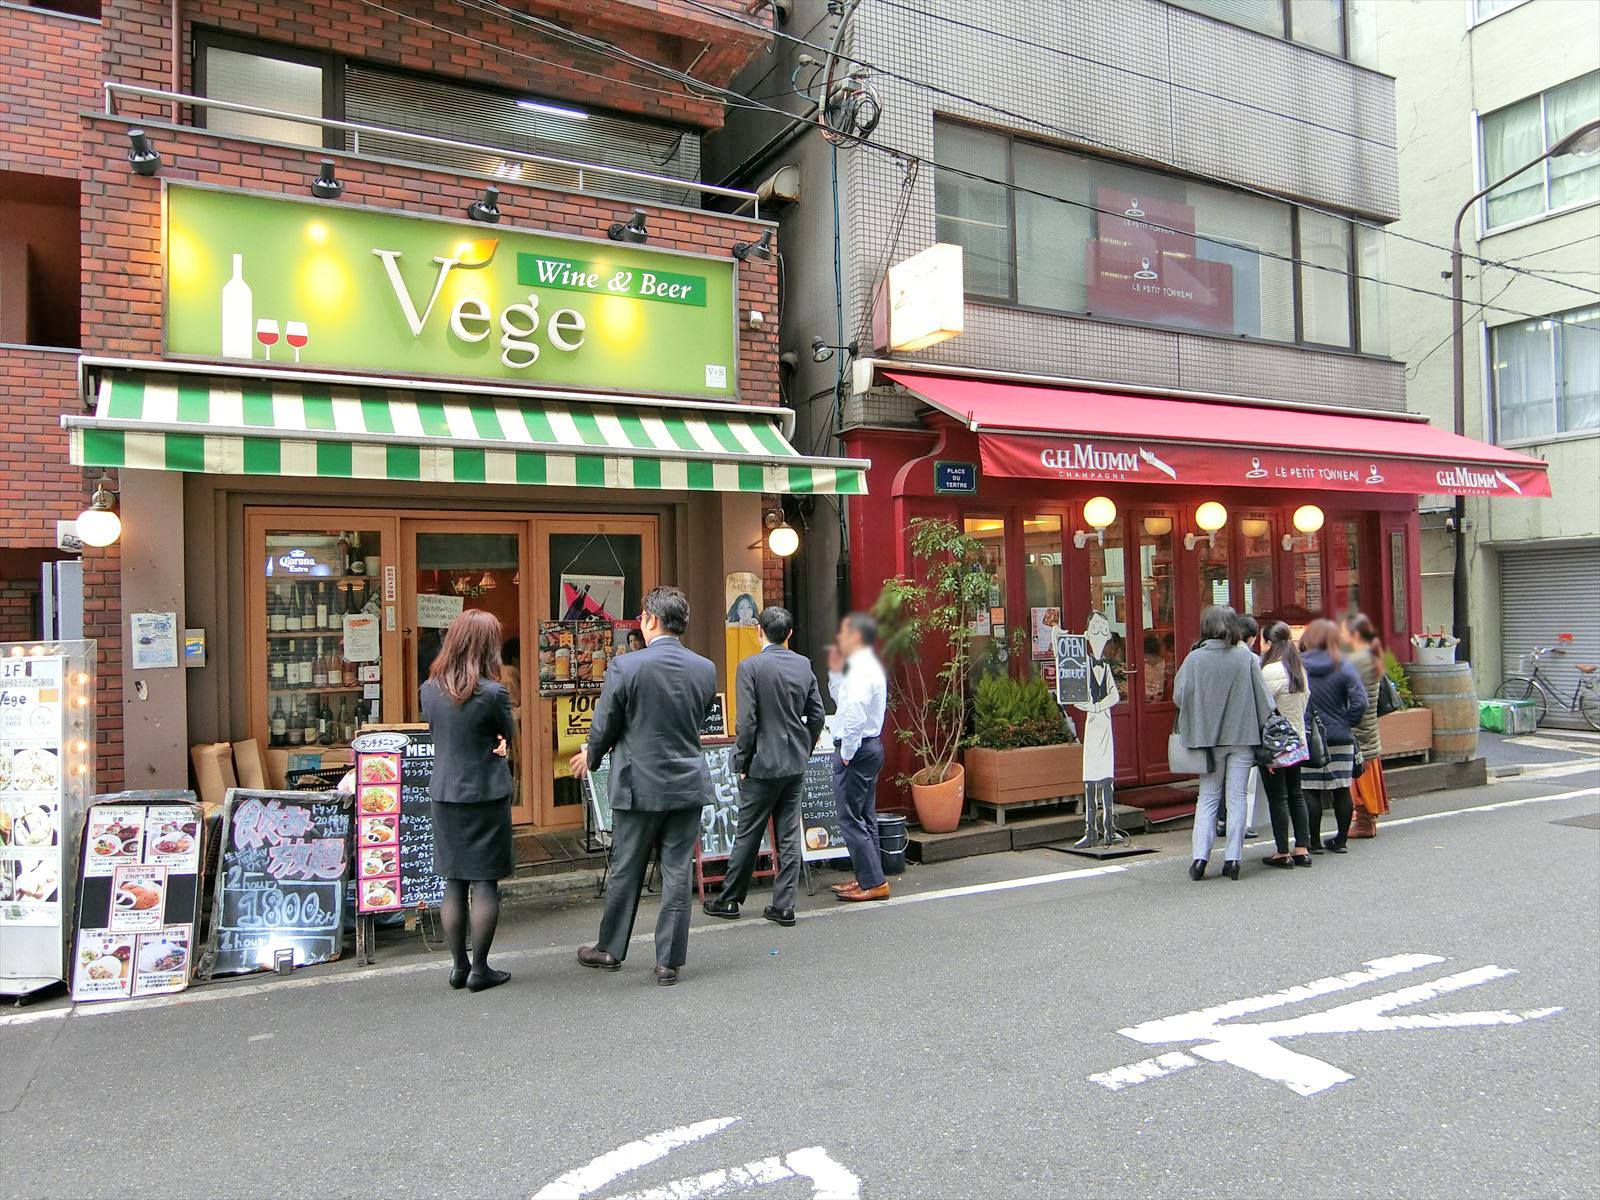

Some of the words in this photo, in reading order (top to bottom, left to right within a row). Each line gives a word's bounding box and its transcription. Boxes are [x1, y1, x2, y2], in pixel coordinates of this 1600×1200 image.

[535, 259, 599, 289] Wine
[607, 271, 633, 293] &
[639, 275, 692, 300] Beer
[371, 248, 587, 370] Vege
[947, 467, 966, 475] PLACE
[1058, 471, 1126, 480] CHAMPAGNE
[1275, 466, 1287, 478] LE
[945, 481, 968, 489] TERTRE
[279, 556, 316, 568] Corona
[288, 565, 309, 573] Extra
[1058, 637, 1085, 658] OPEN
[360, 738, 400, 749] ランチメニュー
[312, 804, 338, 815] ドリンク
